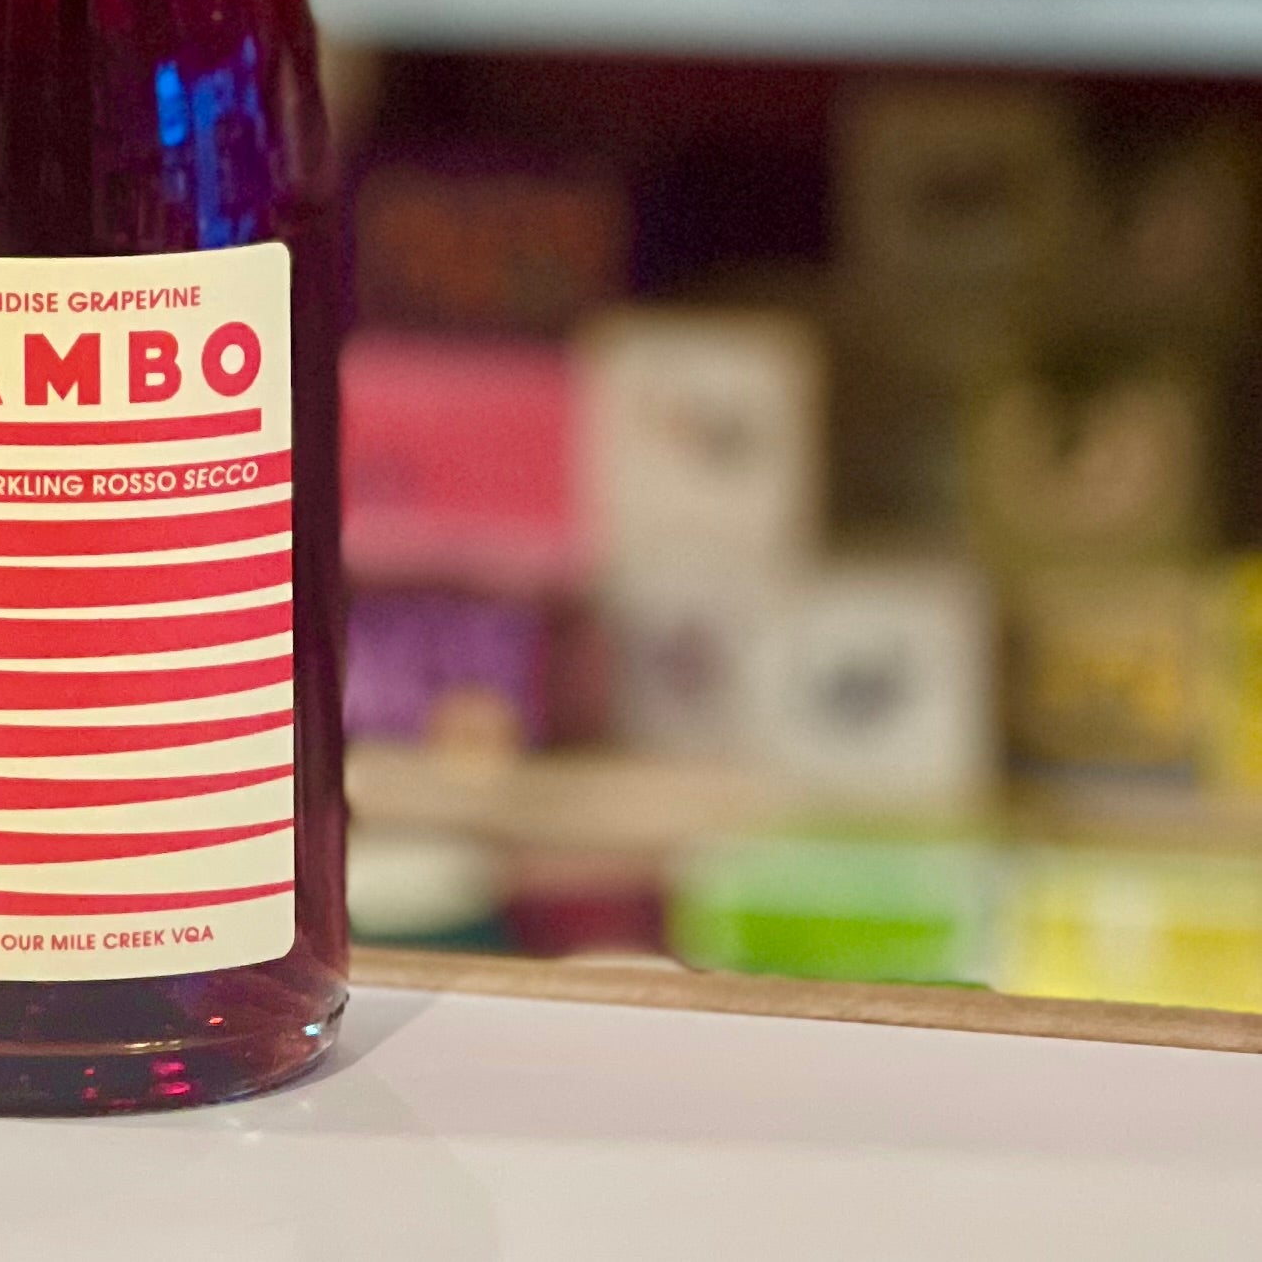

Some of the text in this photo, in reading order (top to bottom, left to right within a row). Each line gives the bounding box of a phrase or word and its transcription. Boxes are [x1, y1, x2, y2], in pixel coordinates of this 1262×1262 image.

[67, 285, 202, 314] GRAPEVINE
[92, 470, 178, 496] ROSSO
[183, 460, 259, 490] SECCO
[50, 933, 96, 951] MILE
[102, 928, 166, 950] CREEK
[171, 924, 215, 945] VQA
